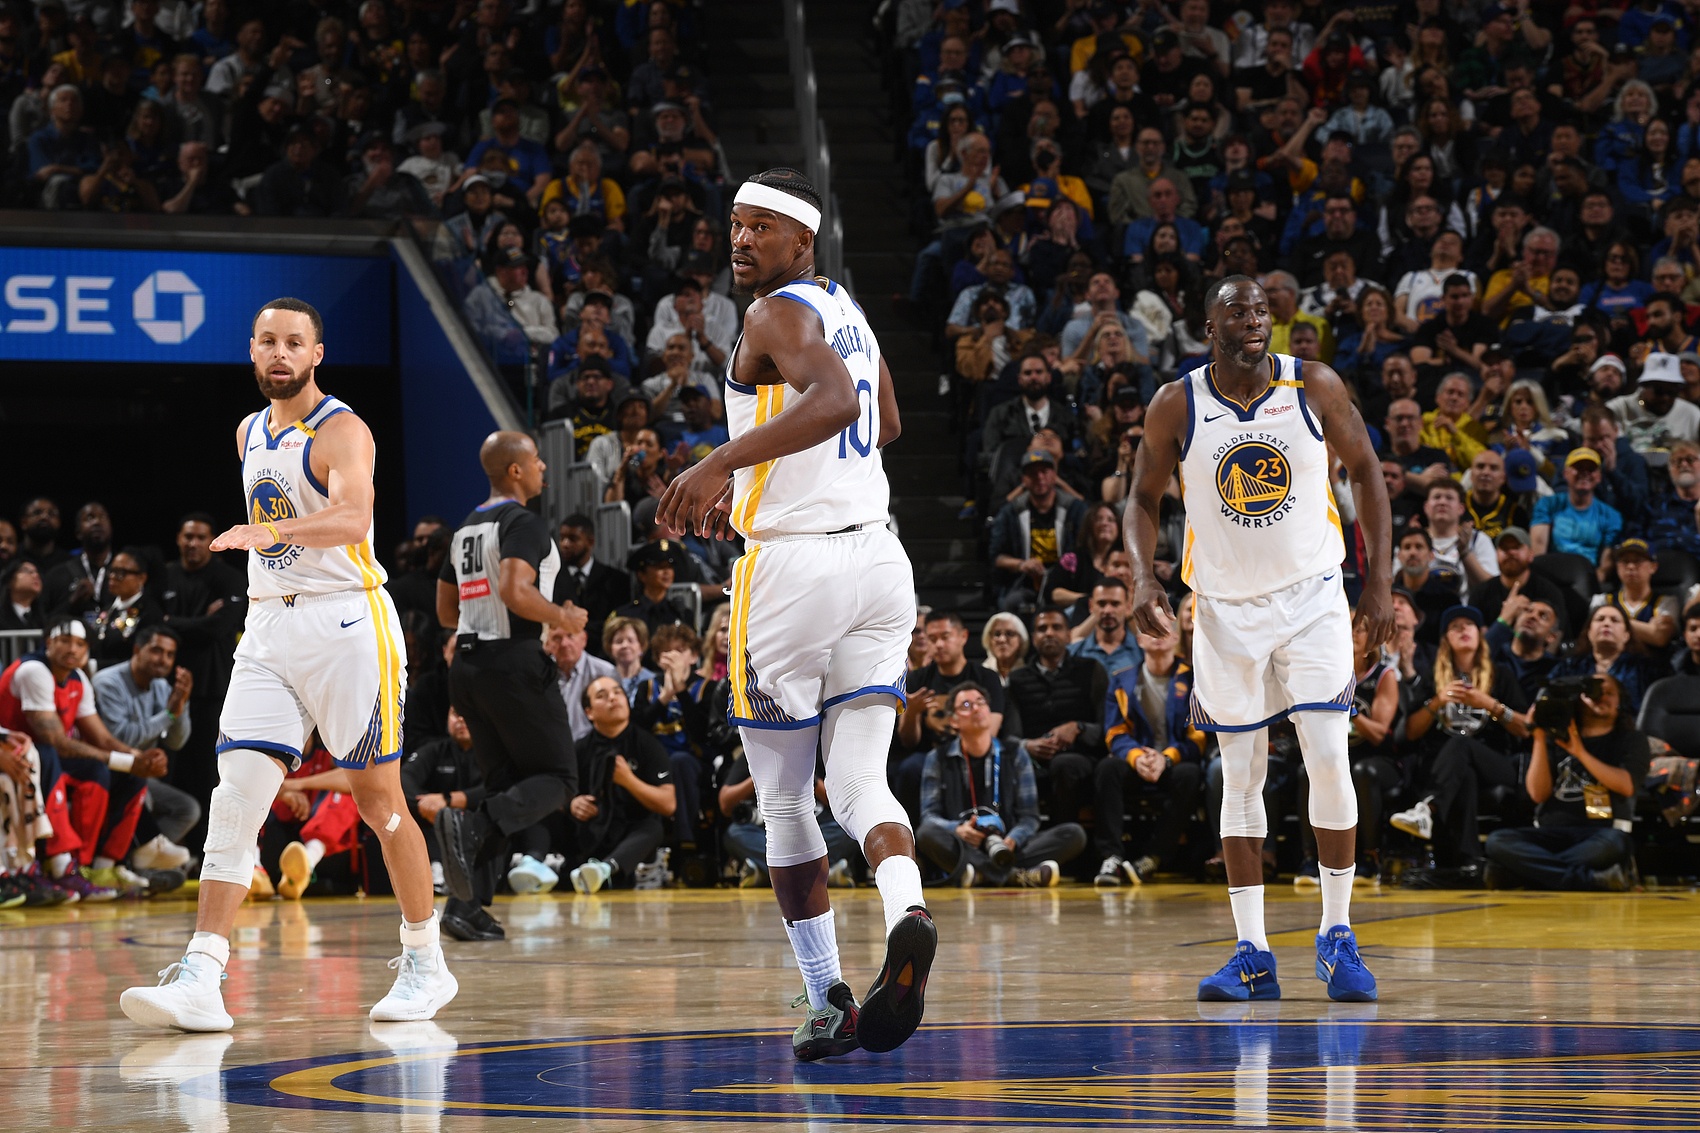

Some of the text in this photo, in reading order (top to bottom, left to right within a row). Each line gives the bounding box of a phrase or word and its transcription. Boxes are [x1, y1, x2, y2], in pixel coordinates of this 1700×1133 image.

[0, 275, 115, 335] SE
[1264, 404, 1294, 416] Rakuten
[281, 440, 304, 449] Rakuten
[1212, 432, 1290, 461] GOLDEN STATE
[1255, 457, 1282, 479] 23
[246, 468, 293, 495] GOLDEN STATE
[269, 497, 288, 519] 30
[1220, 494, 1296, 528] WARRIORS
[260, 545, 305, 570] RRIORS
[461, 533, 484, 575] 30
